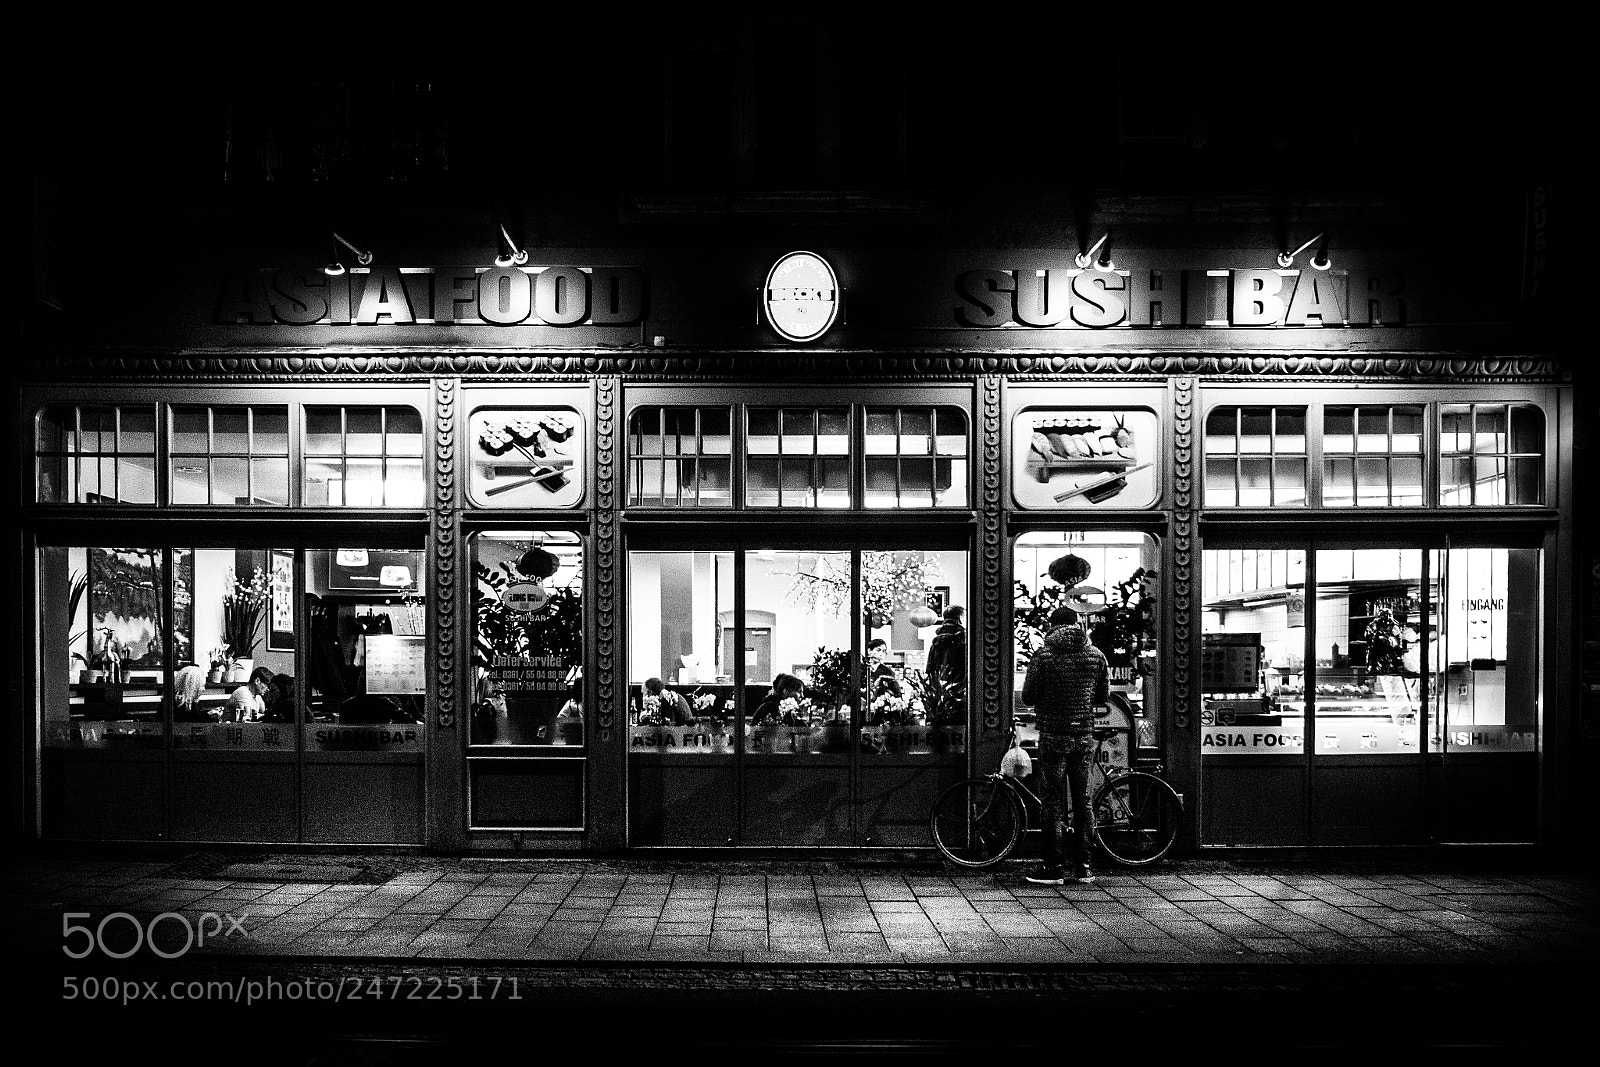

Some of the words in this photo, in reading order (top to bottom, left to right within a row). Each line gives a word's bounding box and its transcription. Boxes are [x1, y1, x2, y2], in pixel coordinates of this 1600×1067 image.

[212, 266, 416, 326] ASIA
[430, 266, 649, 327] FOOD
[953, 268, 1207, 328] SUSHI
[1226, 268, 1407, 328] BAR
[1461, 598, 1504, 611] EINGANG
[631, 733, 677, 747] ASIA
[1202, 733, 1247, 747] ASIA
